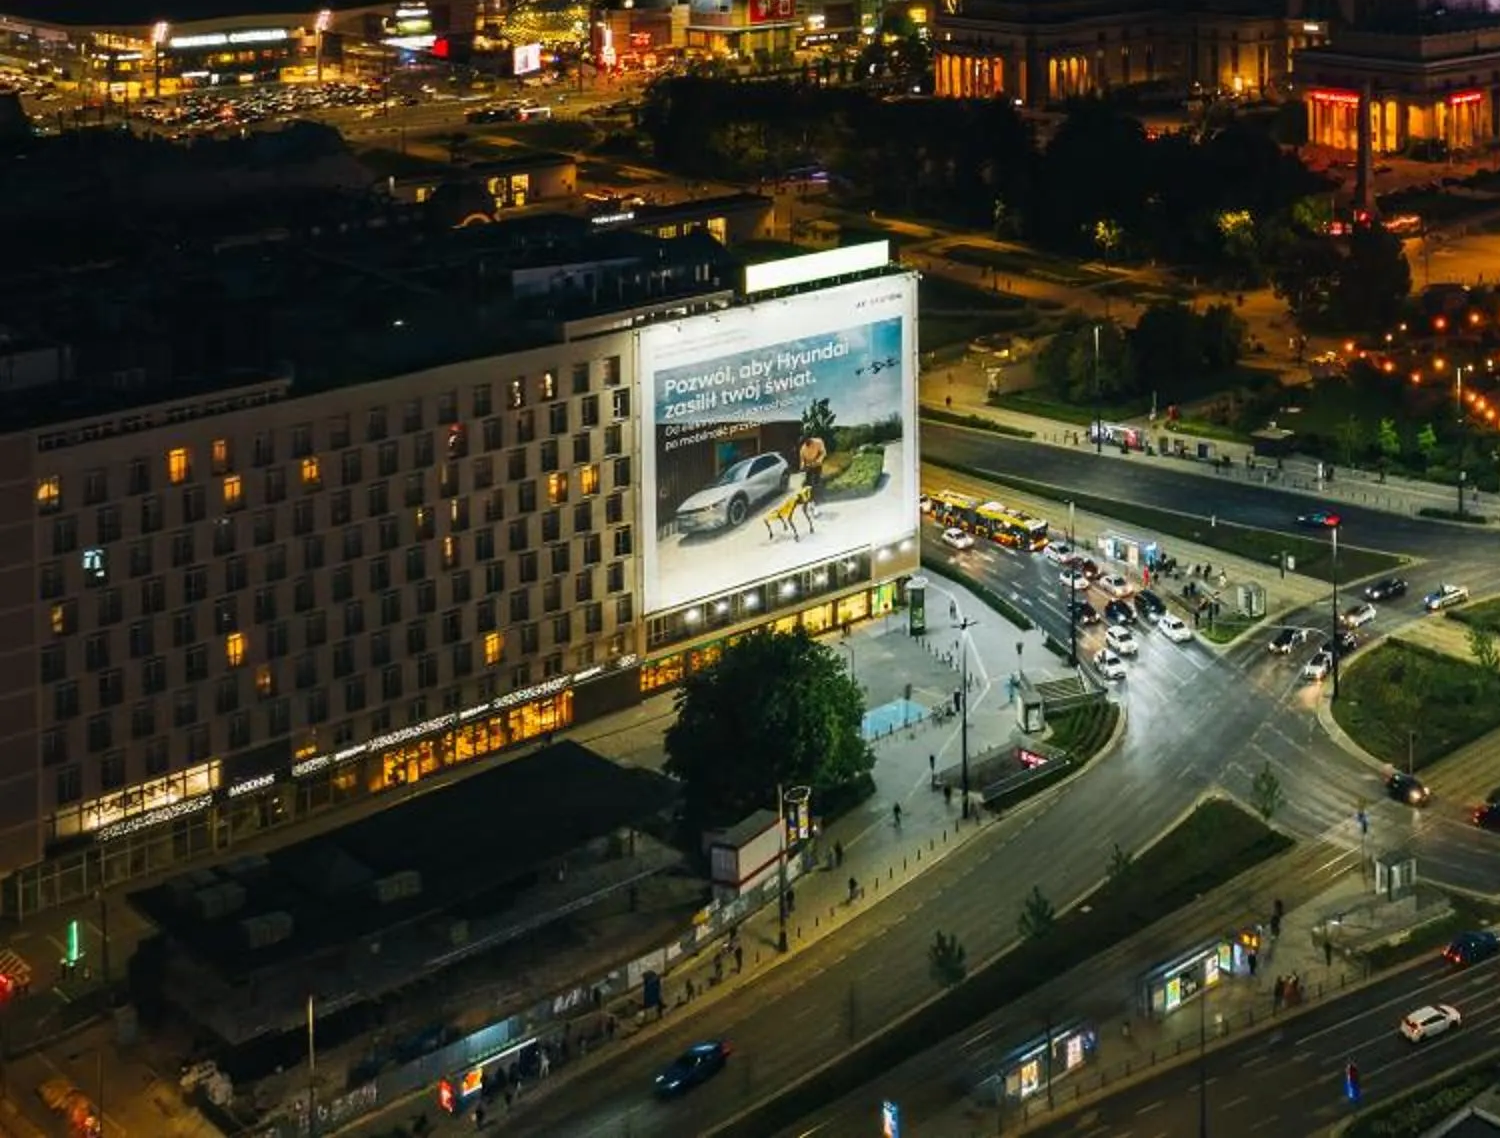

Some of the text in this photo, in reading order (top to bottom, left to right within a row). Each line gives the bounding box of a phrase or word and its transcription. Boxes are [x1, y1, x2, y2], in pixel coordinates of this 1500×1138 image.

[665, 364, 736, 398] Pozwól,
[739, 360, 774, 380] aby
[777, 338, 850, 371] Hyundai
[721, 380, 761, 405] twój
[765, 370, 818, 394] świat.
